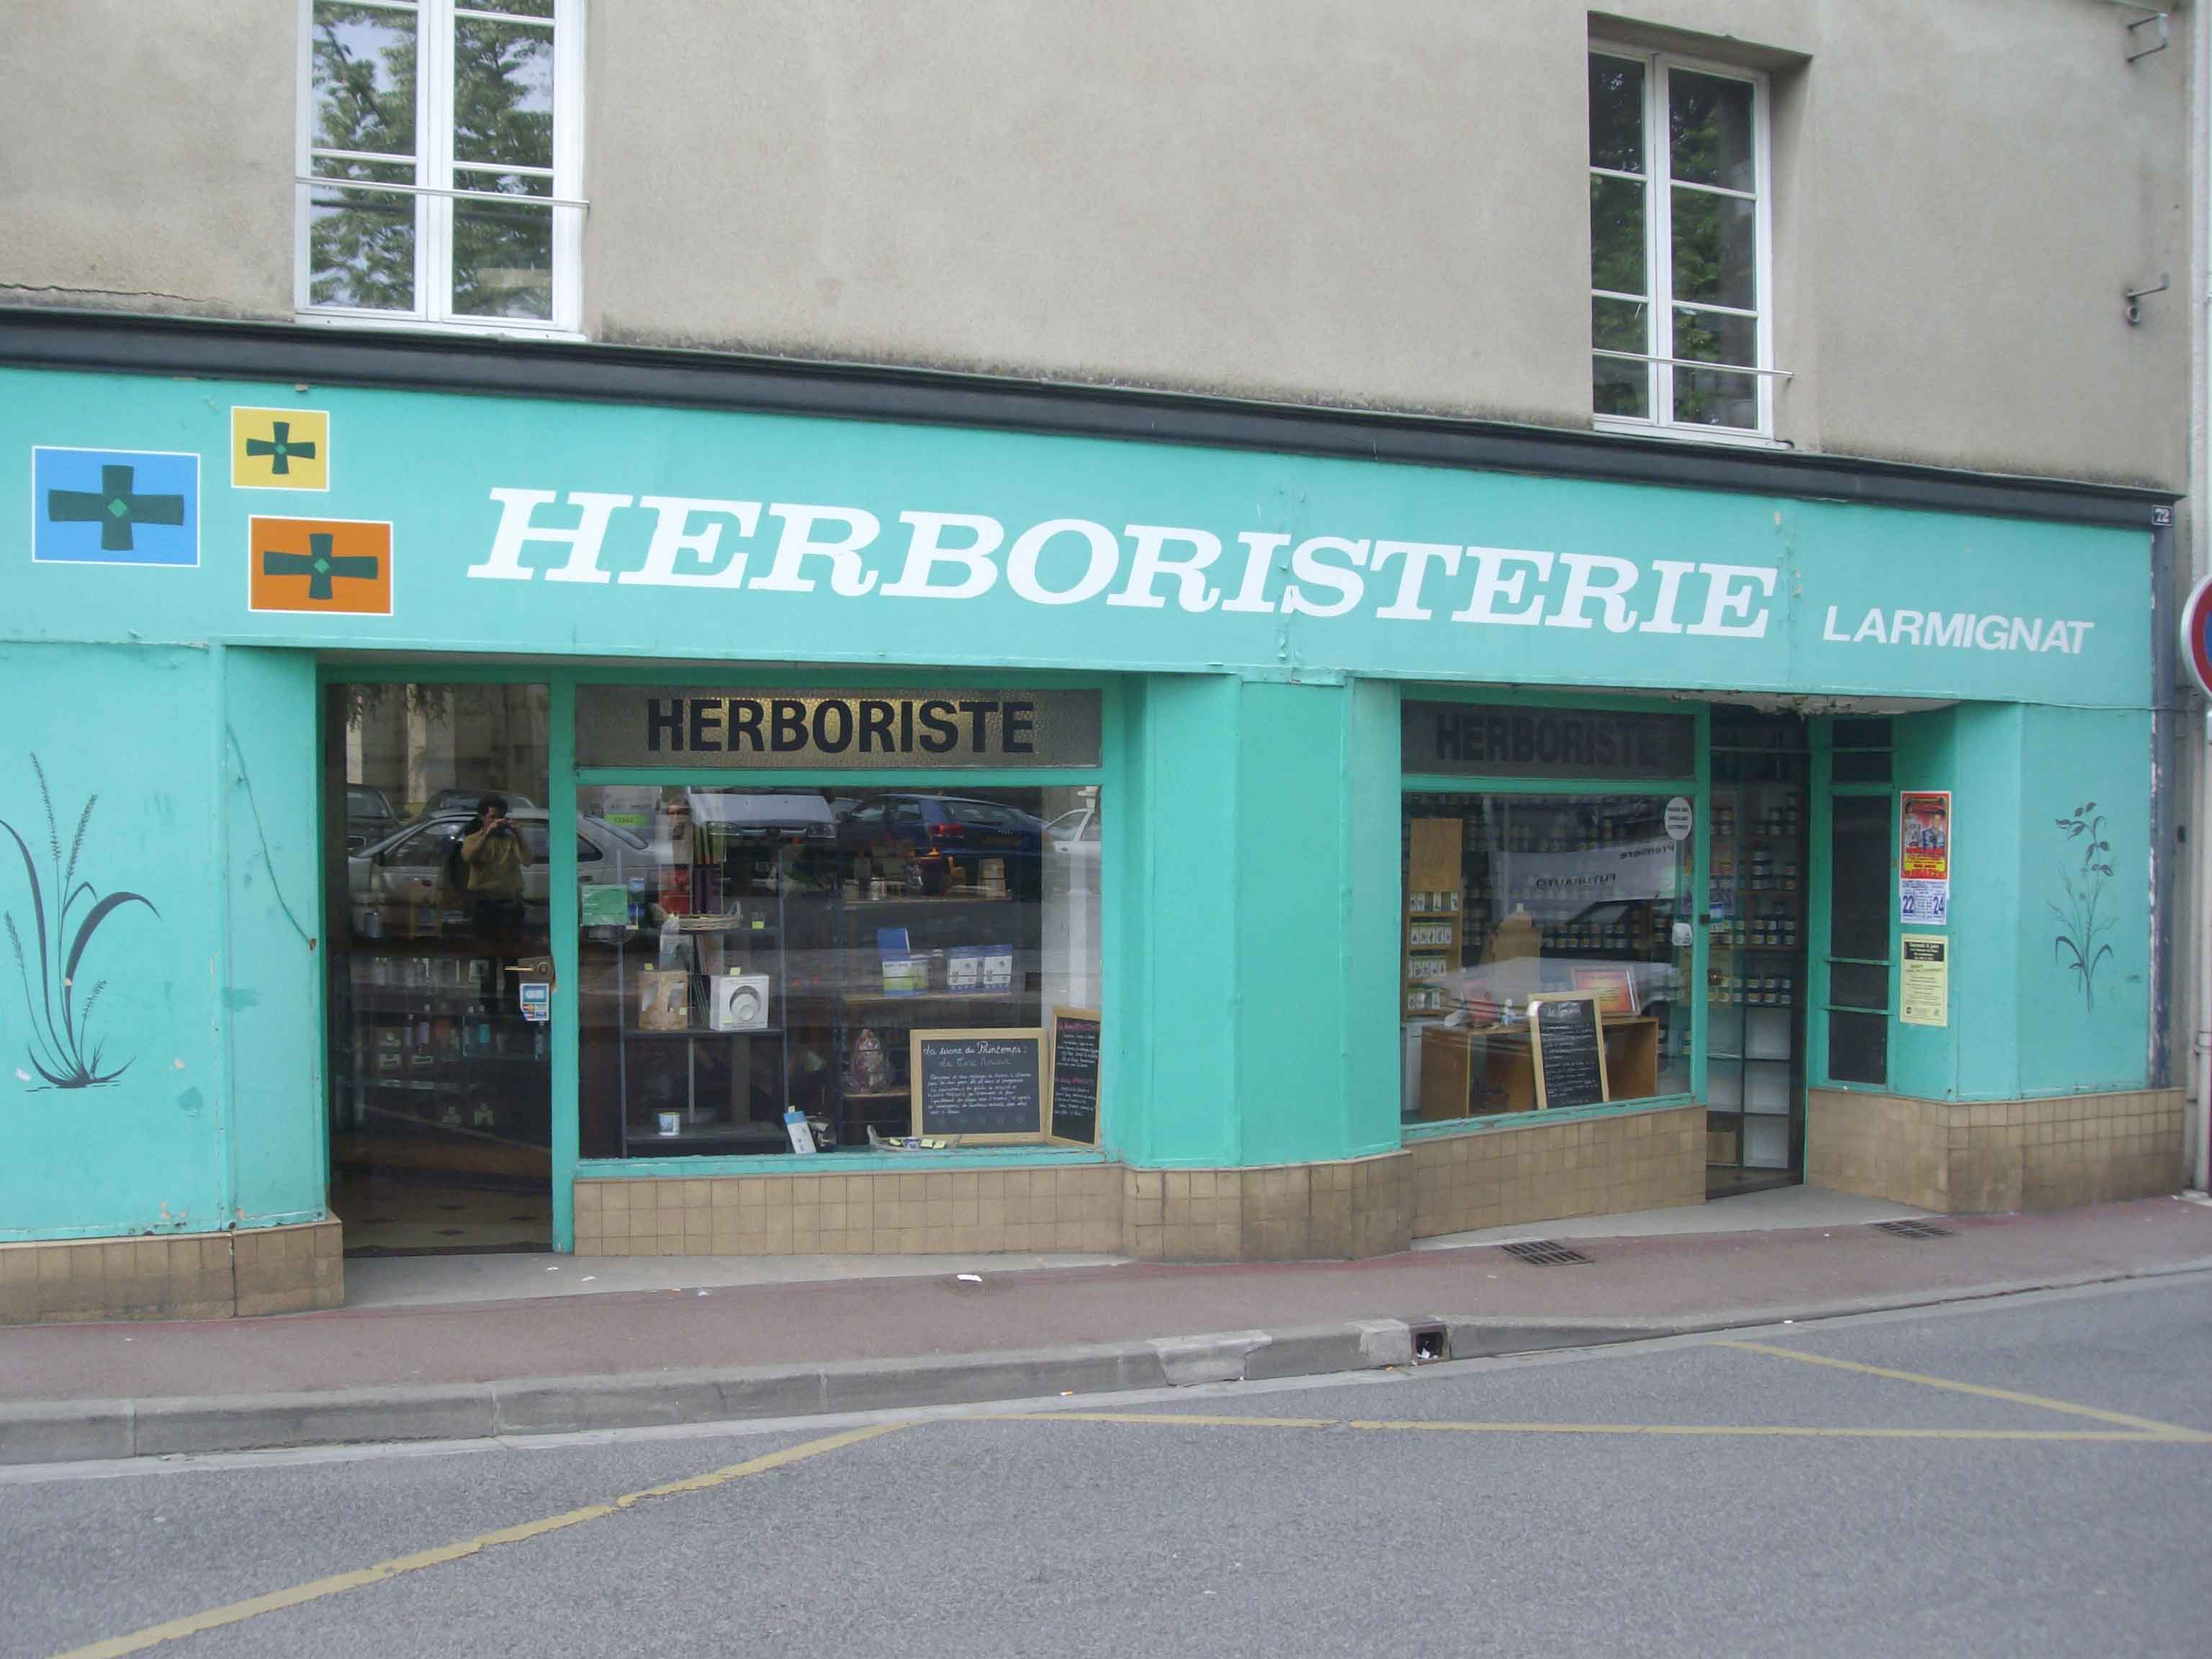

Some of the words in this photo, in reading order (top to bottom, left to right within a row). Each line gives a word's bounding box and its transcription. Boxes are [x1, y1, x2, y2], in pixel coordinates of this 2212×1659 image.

[2154, 508, 2170, 522] 72
[467, 487, 1776, 637] HERBORISTERIE
[1823, 606, 2095, 654] LARMIGNAT
[647, 698, 1034, 753] HERBORISTE
[1436, 713, 1660, 767] HERBORISTE
[1902, 895, 1914, 913] 22
